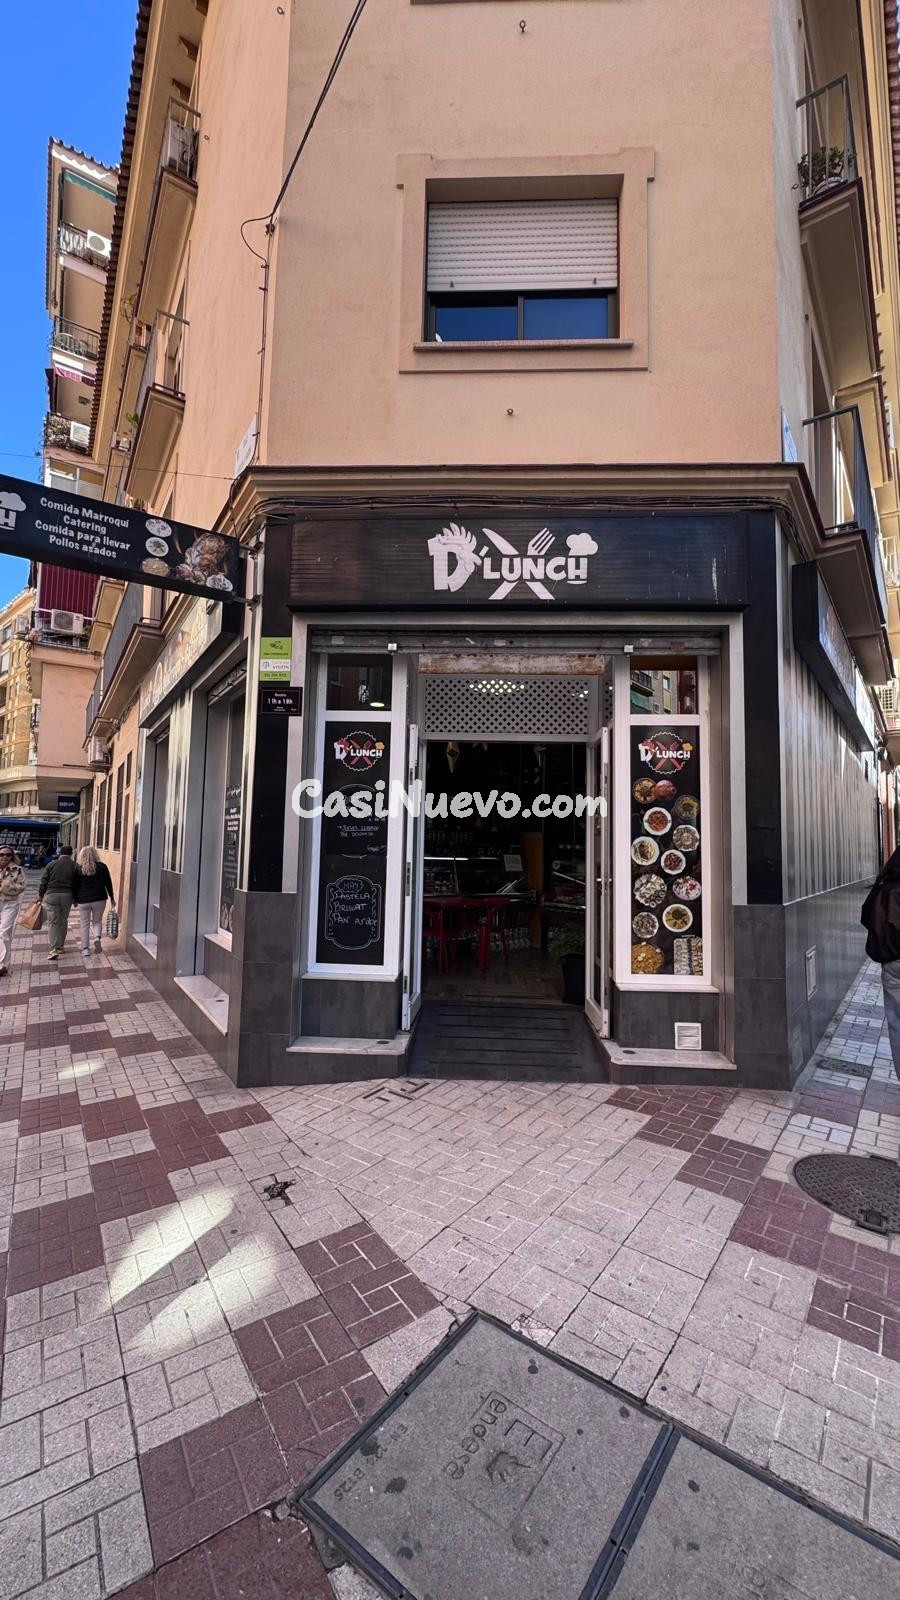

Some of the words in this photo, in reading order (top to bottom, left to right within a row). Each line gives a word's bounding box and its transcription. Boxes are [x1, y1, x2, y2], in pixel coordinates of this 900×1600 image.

[40, 497, 79, 515] Comida
[35, 520, 75, 538] Comida
[77, 531, 101, 544] para
[103, 536, 131, 550] llevar
[63, 515, 107, 535] Catering
[49, 534, 80, 550] Pollos
[81, 543, 117, 558] asados
[427, 530, 588, 592] D'LUNCH
